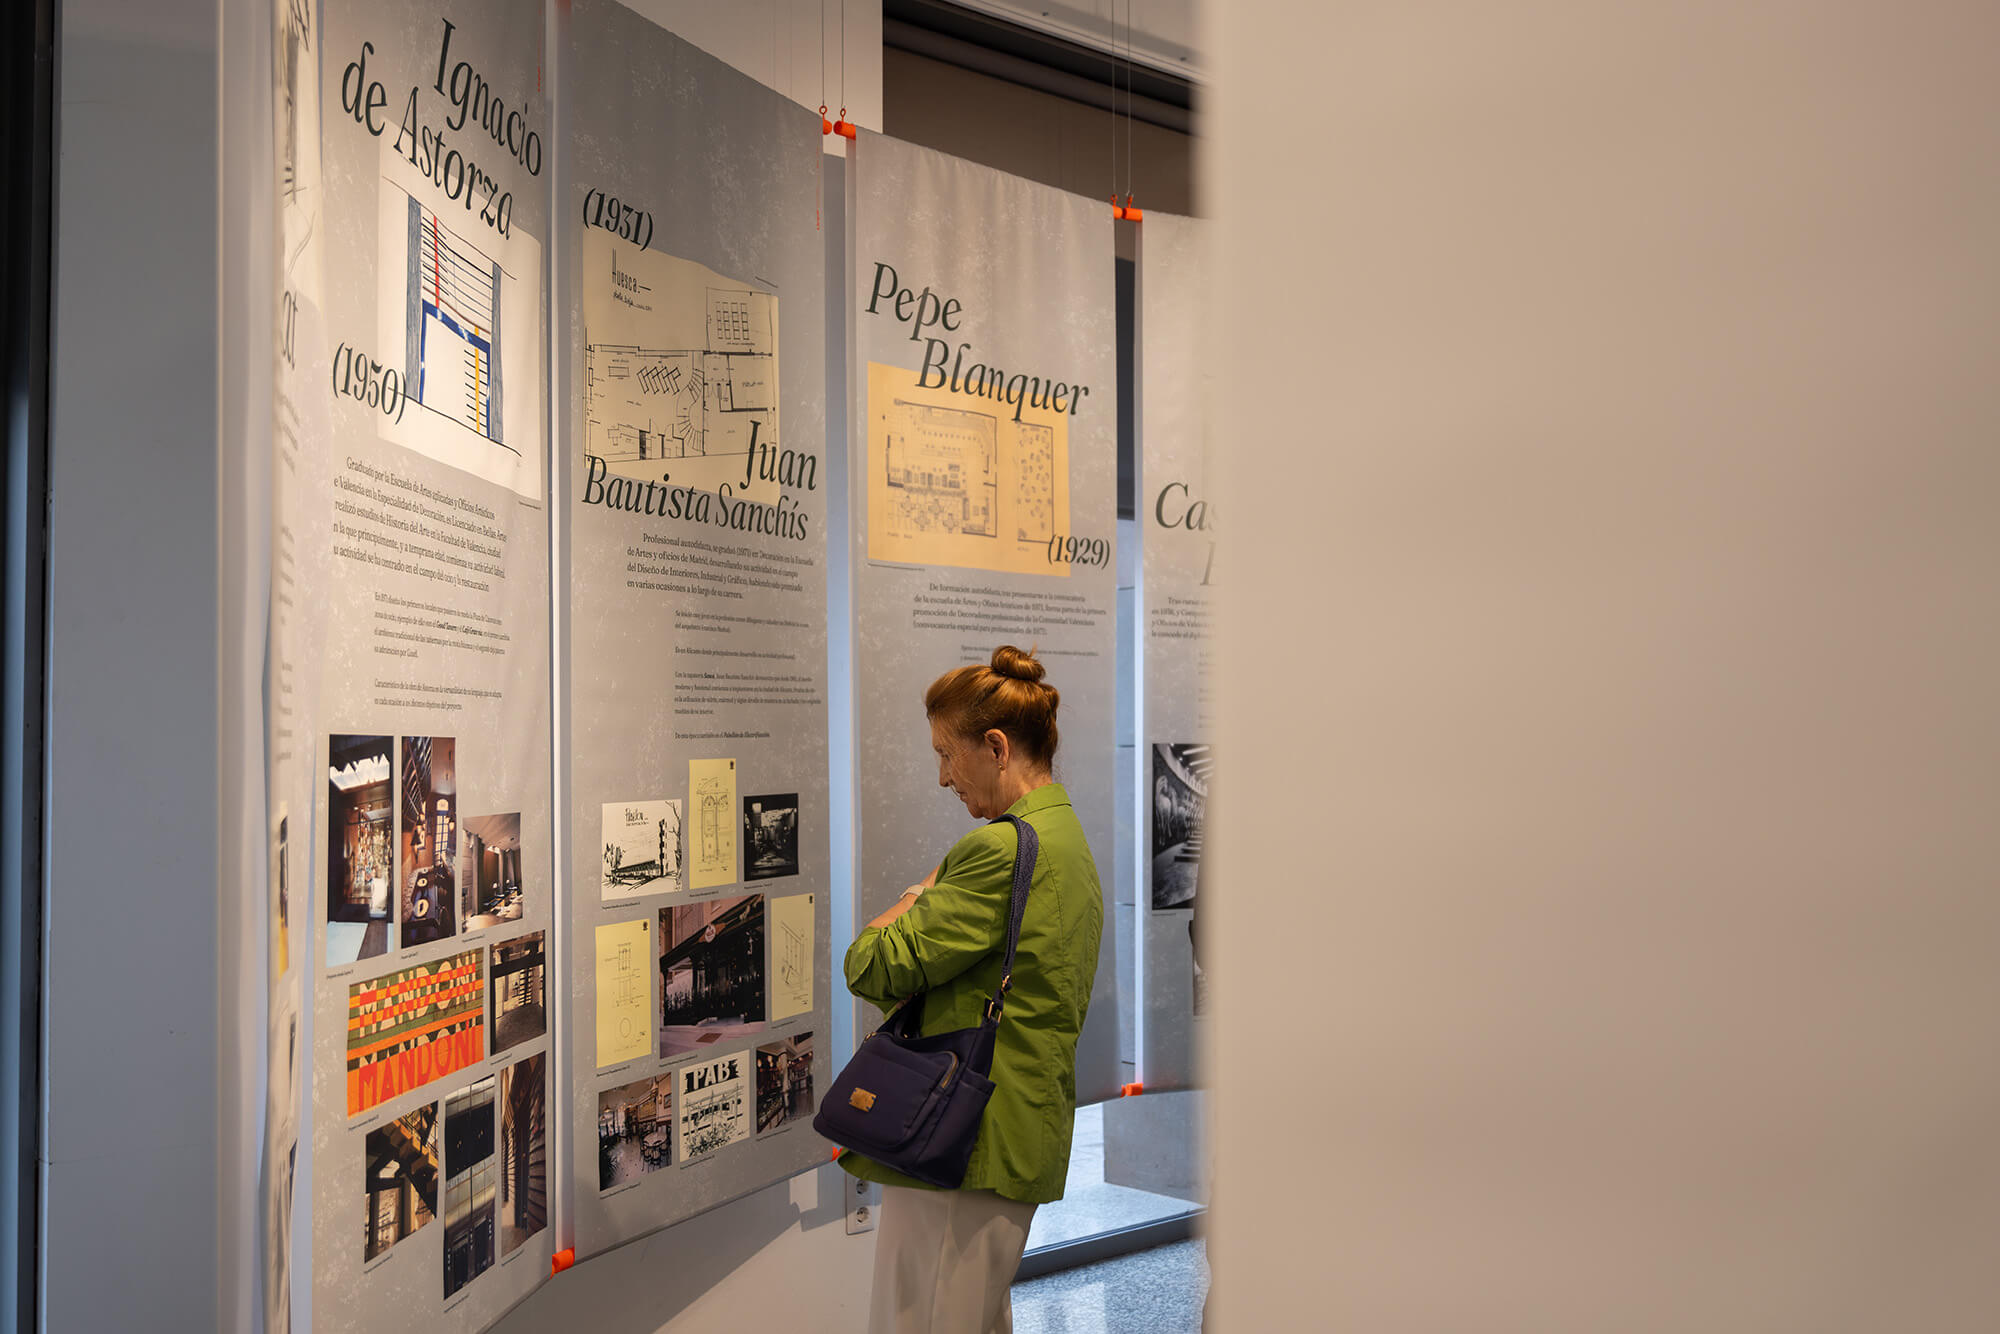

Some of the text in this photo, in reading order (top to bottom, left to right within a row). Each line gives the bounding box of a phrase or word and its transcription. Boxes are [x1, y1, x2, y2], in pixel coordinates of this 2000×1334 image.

[434, 17, 542, 176] Ignacio
[342, 41, 513, 240] de Astorza
[582, 188, 653, 251] (1931)
[865, 262, 962, 341] Pepe
[333, 342, 406, 425] (1950)
[915, 337, 1089, 422] Blanquer
[339, 476, 364, 495] Valencia
[739, 419, 816, 491] Juan
[582, 454, 808, 541] Bautista Sanchís
[626, 562, 636, 572] del
[635, 548, 652, 558] Artes
[658, 551, 680, 561] oficios
[642, 533, 680, 546] Profesional
[1047, 534, 1110, 569] (1929)
